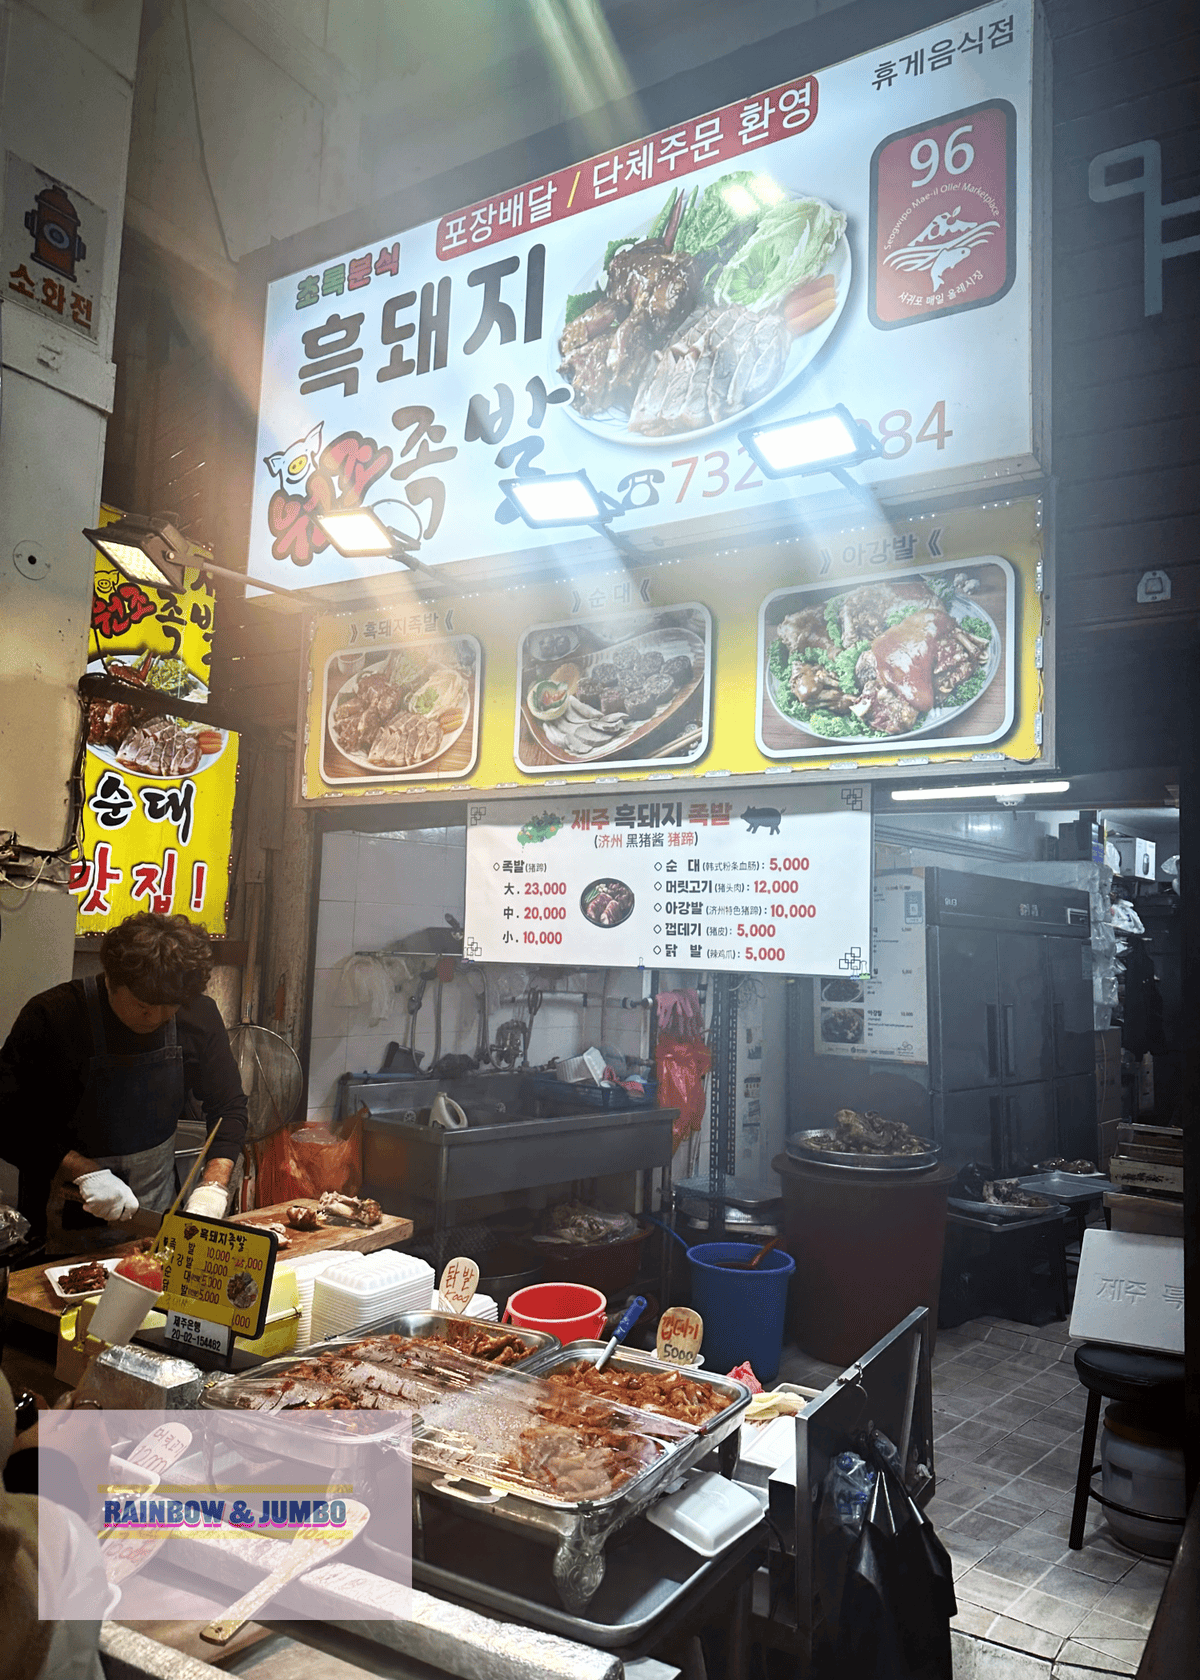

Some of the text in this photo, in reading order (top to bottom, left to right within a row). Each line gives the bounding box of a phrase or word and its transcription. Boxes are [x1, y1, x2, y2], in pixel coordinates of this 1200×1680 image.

[872, 15, 1014, 90] 휴게음식점
[442, 181, 557, 252] 포장배달
[593, 117, 724, 199] 단체주문
[738, 81, 812, 145] 환영
[910, 125, 975, 188] 96
[884, 207, 912, 250] Seogwipo
[962, 182, 999, 217] Marketplace
[295, 242, 401, 310] 초록분식
[9, 263, 92, 330] 소화전
[898, 291, 923, 306] 서귀포
[926, 293, 944, 305] 매일
[298, 243, 546, 397] 흑돼지
[390, 376, 572, 541] 족발
[841, 534, 918, 569] 아강발
[363, 612, 439, 640] 흑돼지족발
[92, 773, 196, 844] 순대
[571, 802, 732, 831] 제주 흑돼지 족발
[769, 857, 810, 872] 5,000
[524, 882, 567, 896] 23,000
[754, 880, 799, 894] 12,000
[523, 906, 566, 920] 20,000
[665, 901, 703, 915] 아강발
[770, 904, 816, 918] 10,000
[523, 930, 563, 945] 10,000
[665, 922, 701, 937] 껍데기
[737, 924, 776, 938] 5,000
[745, 947, 785, 961] 5,000
[200, 1228, 247, 1252] 흑돼지족발
[1096, 1278, 1148, 1306] 제주
[173, 1315, 202, 1333] 제주은행
[663, 1343, 694, 1360] 5000
